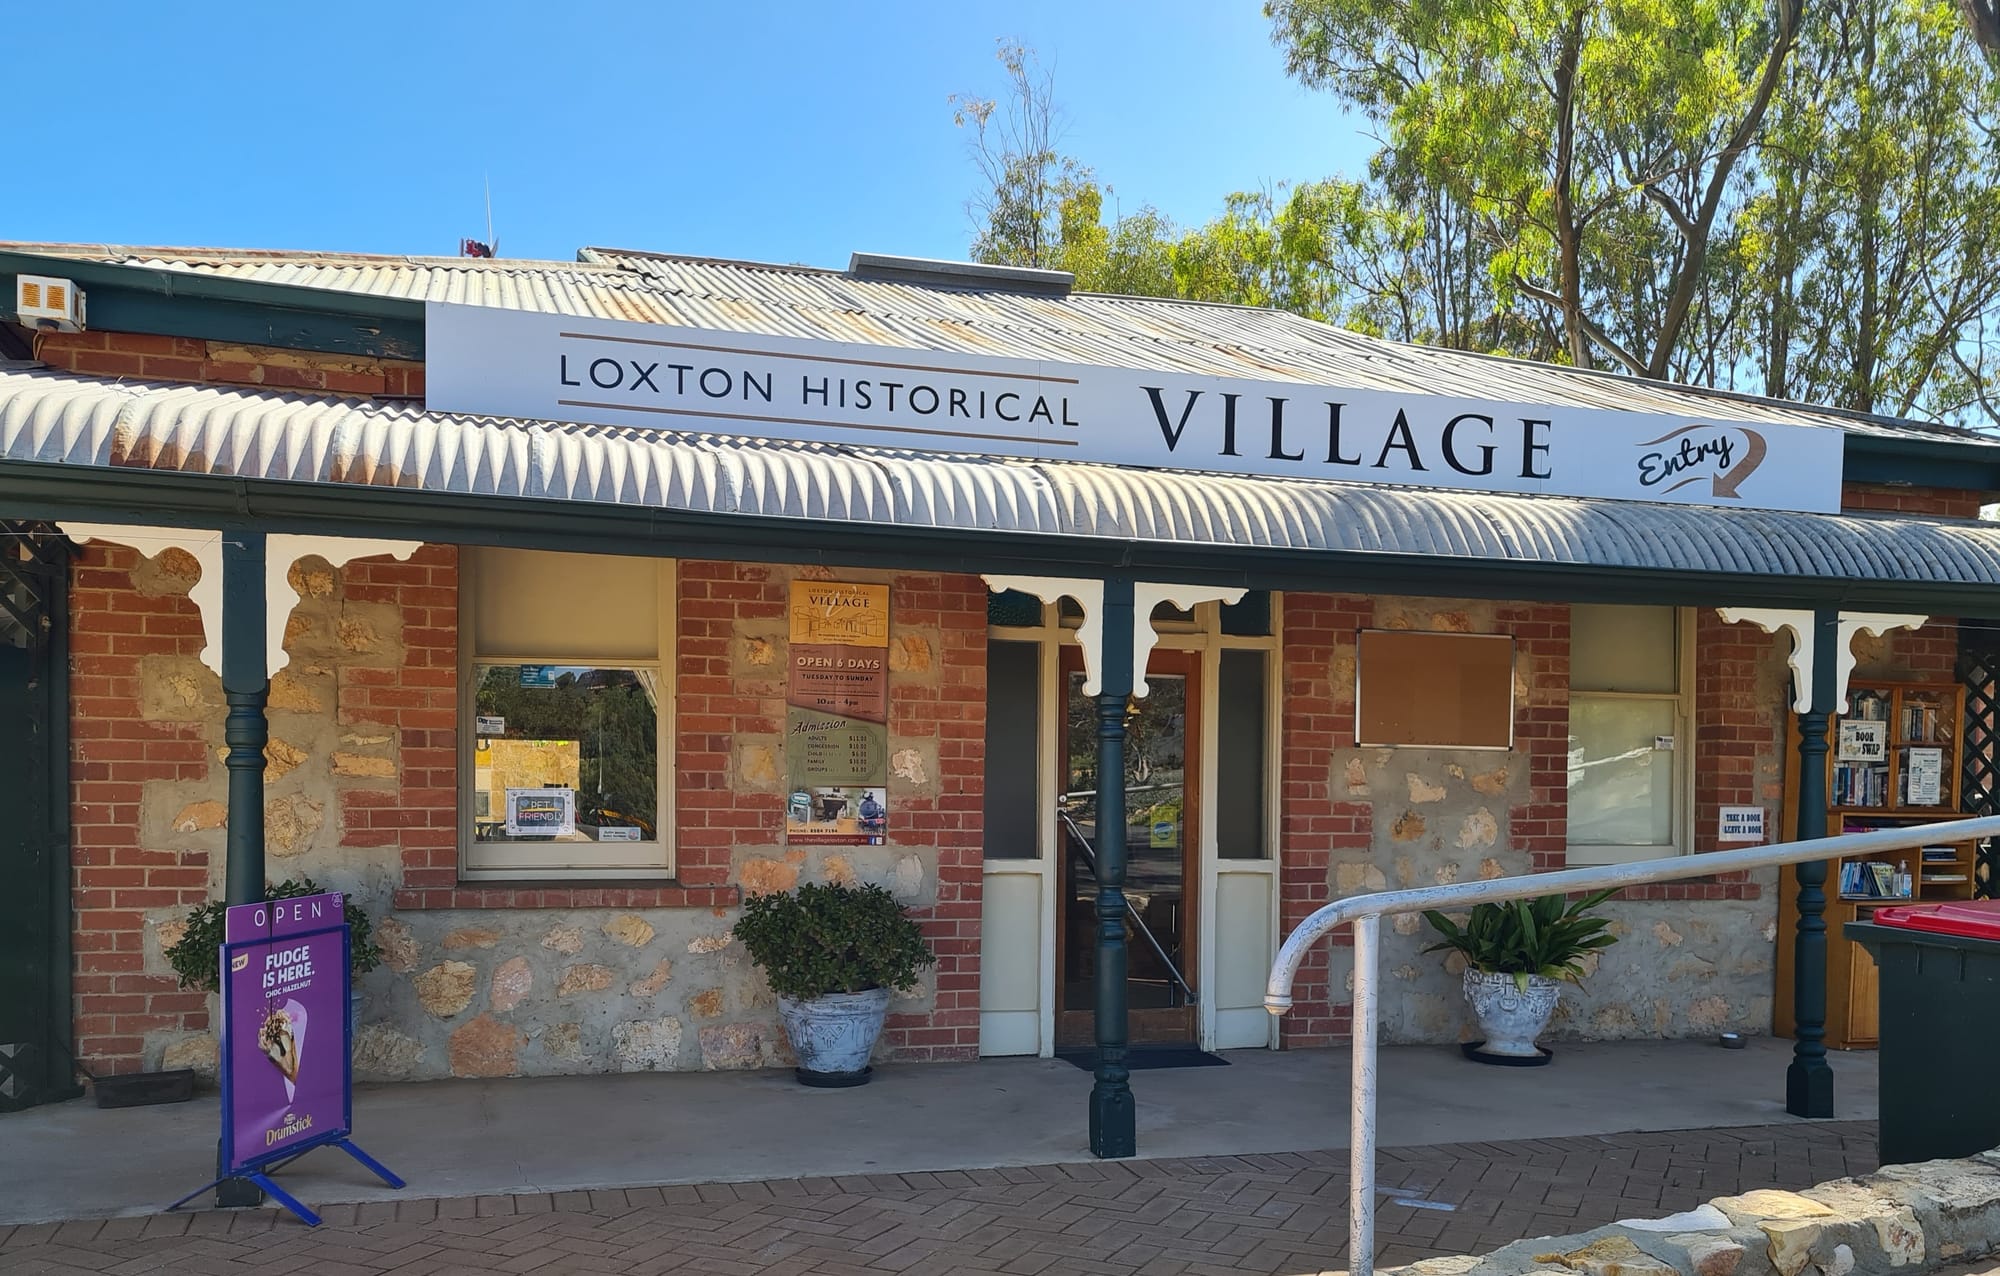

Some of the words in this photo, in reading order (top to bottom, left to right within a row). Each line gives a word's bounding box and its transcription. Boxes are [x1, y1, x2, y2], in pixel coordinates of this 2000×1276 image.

[559, 354, 774, 403] LOXTON
[801, 376, 1080, 427] HISTORICAL
[1138, 385, 1553, 479] VILLAGE
[1637, 428, 1735, 487] Entry
[809, 596, 871, 608] VILLAGE
[796, 656, 833, 668] OPEN
[836, 658, 844, 668] 6
[848, 658, 881, 670] DAYS
[802, 673, 834, 681] TUESDAY
[846, 674, 874, 682] SUNDAY
[791, 720, 847, 735] Admission
[1855, 731, 1874, 742] BOOK
[1862, 743, 1881, 755] SWAP
[531, 800, 551, 809] PET
[518, 812, 563, 821] FRIENDLY
[1726, 813, 1740, 822] TAKE
[1741, 813, 1745, 822] A
[1746, 813, 1761, 822] BOOK
[1724, 825, 1741, 834] LEAVE
[1742, 825, 1746, 834] A
[1748, 825, 1762, 834] BOOK
[254, 900, 322, 927] OPEN
[265, 944, 310, 971] FUDGE
[262, 971, 275, 989] IS
[277, 961, 315, 985] HERE.
[265, 987, 282, 999] CHOC
[282, 979, 312, 994] HAZELNUT
[266, 1113, 313, 1146] Drumstick
